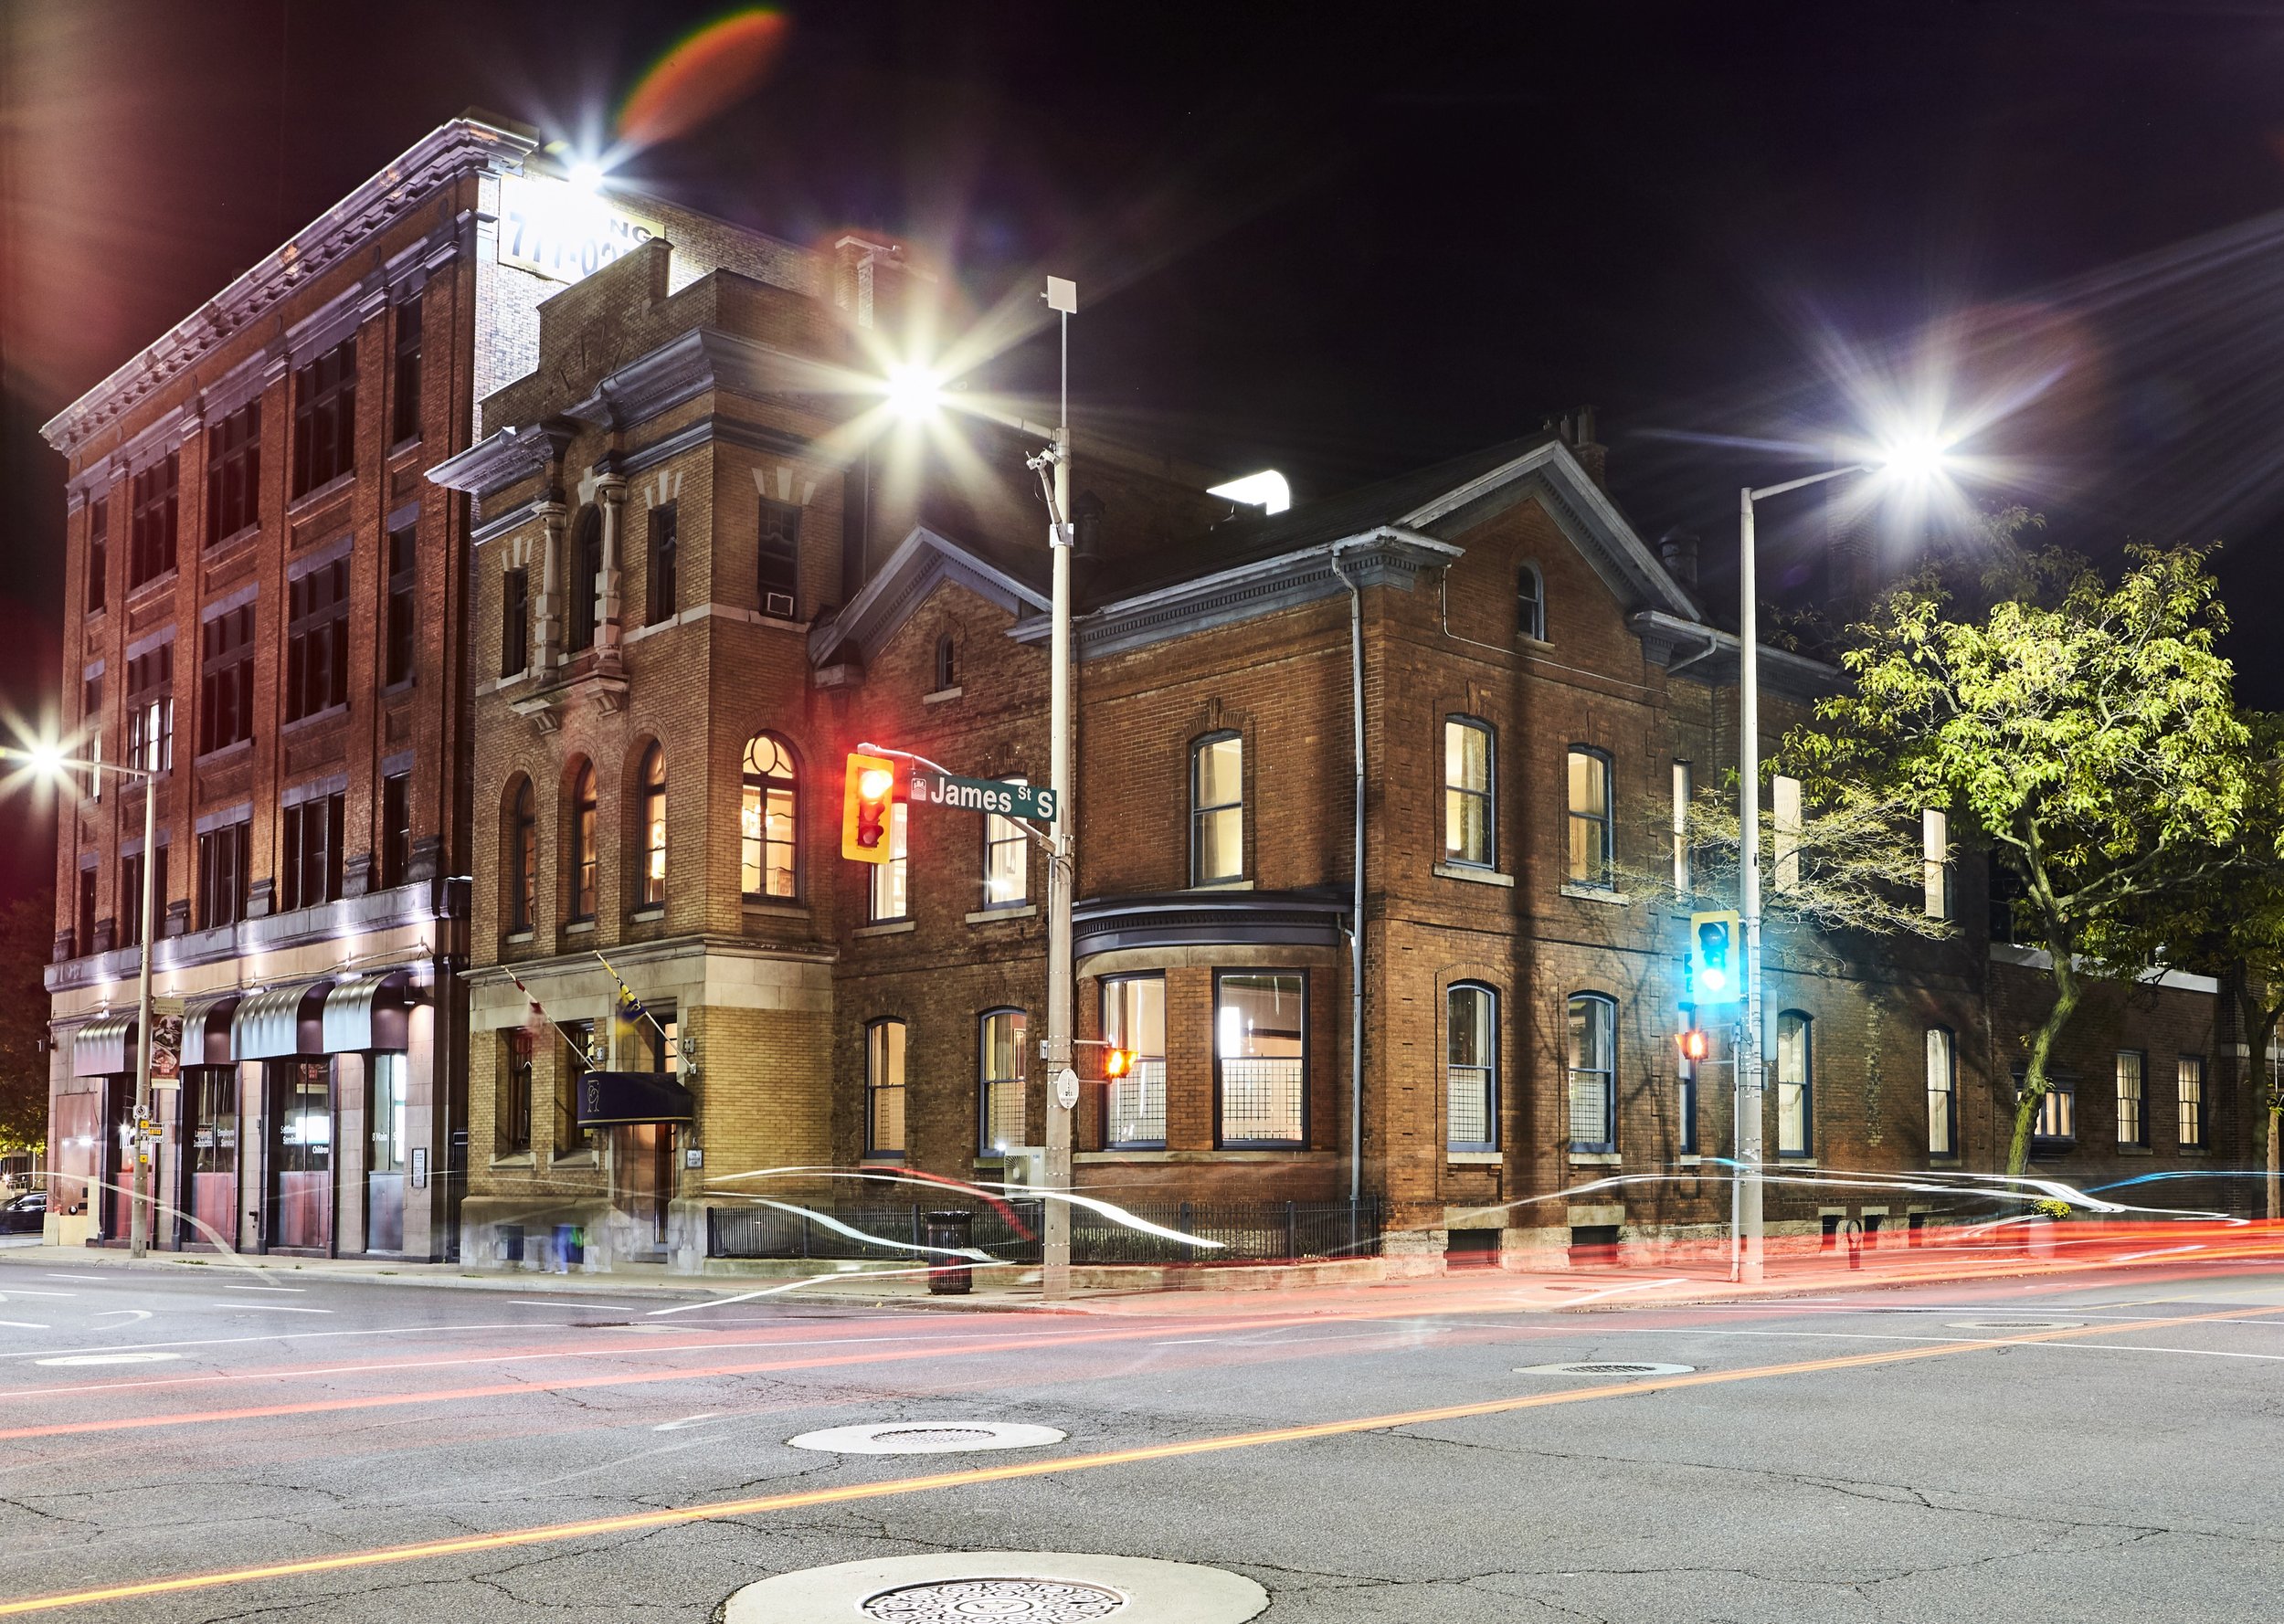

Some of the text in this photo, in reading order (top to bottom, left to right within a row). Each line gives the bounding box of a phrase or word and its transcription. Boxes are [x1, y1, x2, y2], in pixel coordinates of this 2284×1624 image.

[930, 776, 1053, 818] James St S
